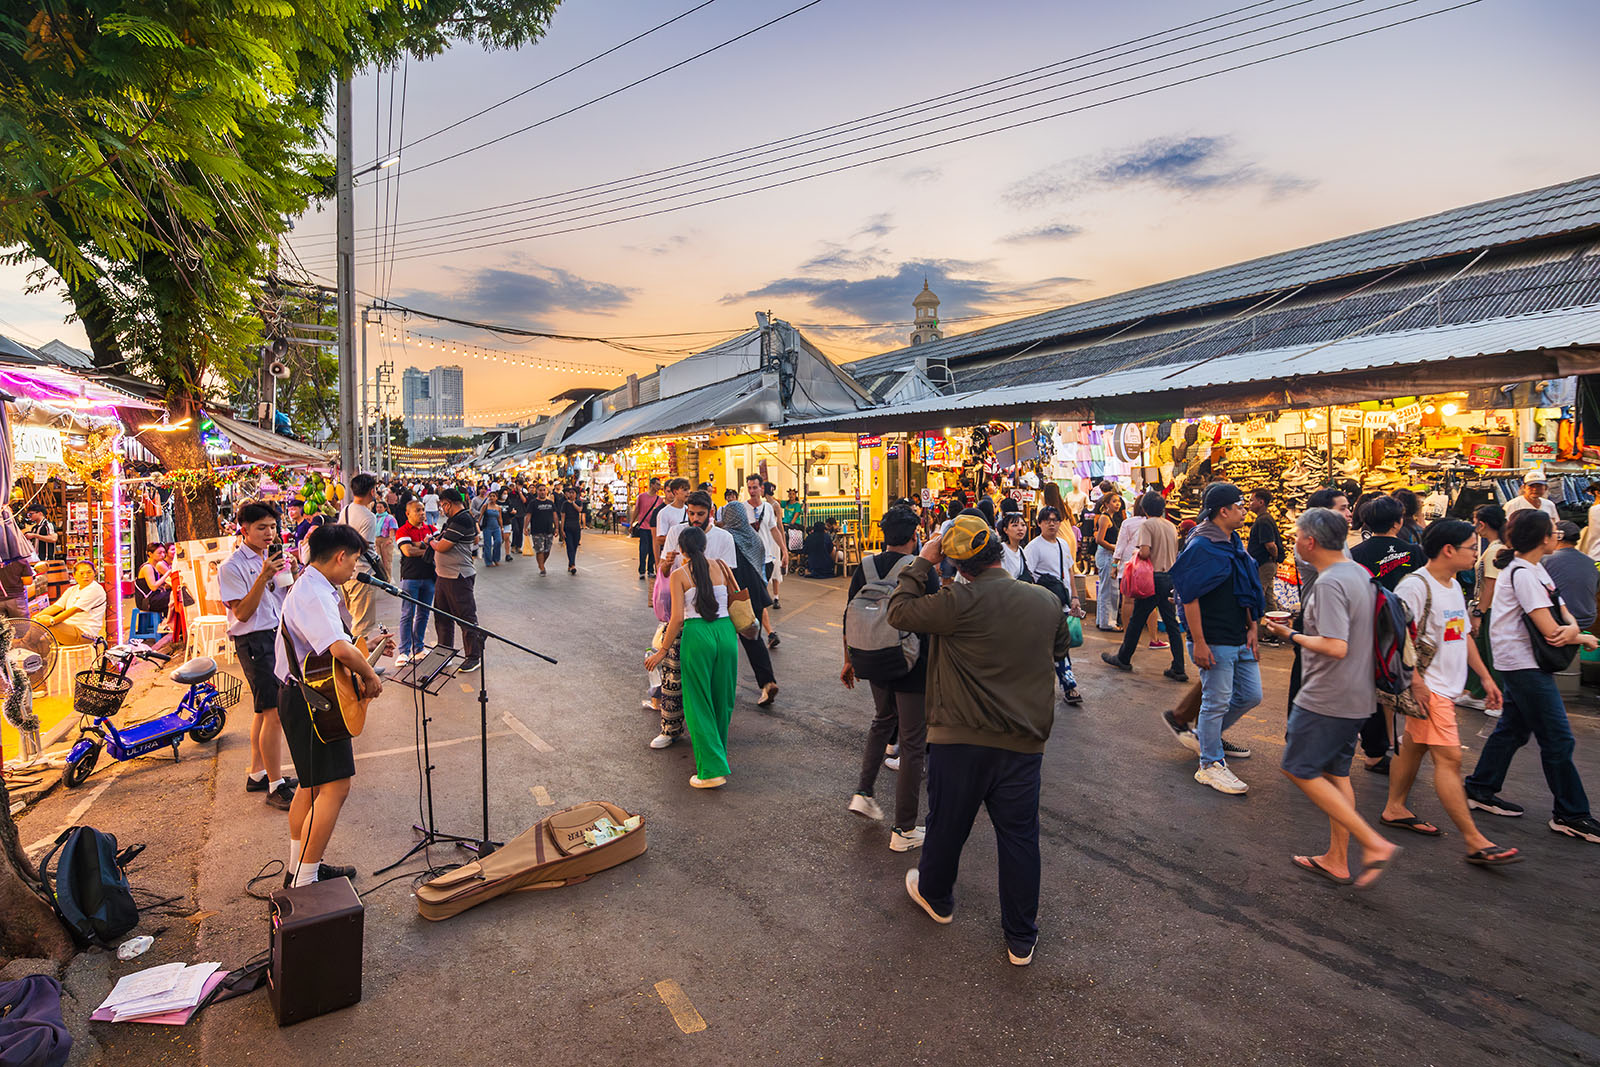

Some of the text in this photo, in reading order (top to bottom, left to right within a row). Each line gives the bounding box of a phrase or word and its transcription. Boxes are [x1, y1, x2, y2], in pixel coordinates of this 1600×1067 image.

[1396, 406, 1418, 419] 280
[1367, 415, 1388, 424] SALE
[1200, 421, 1217, 434] 350
[1246, 420, 1265, 433] 350
[126, 741, 158, 756] ULTRA
